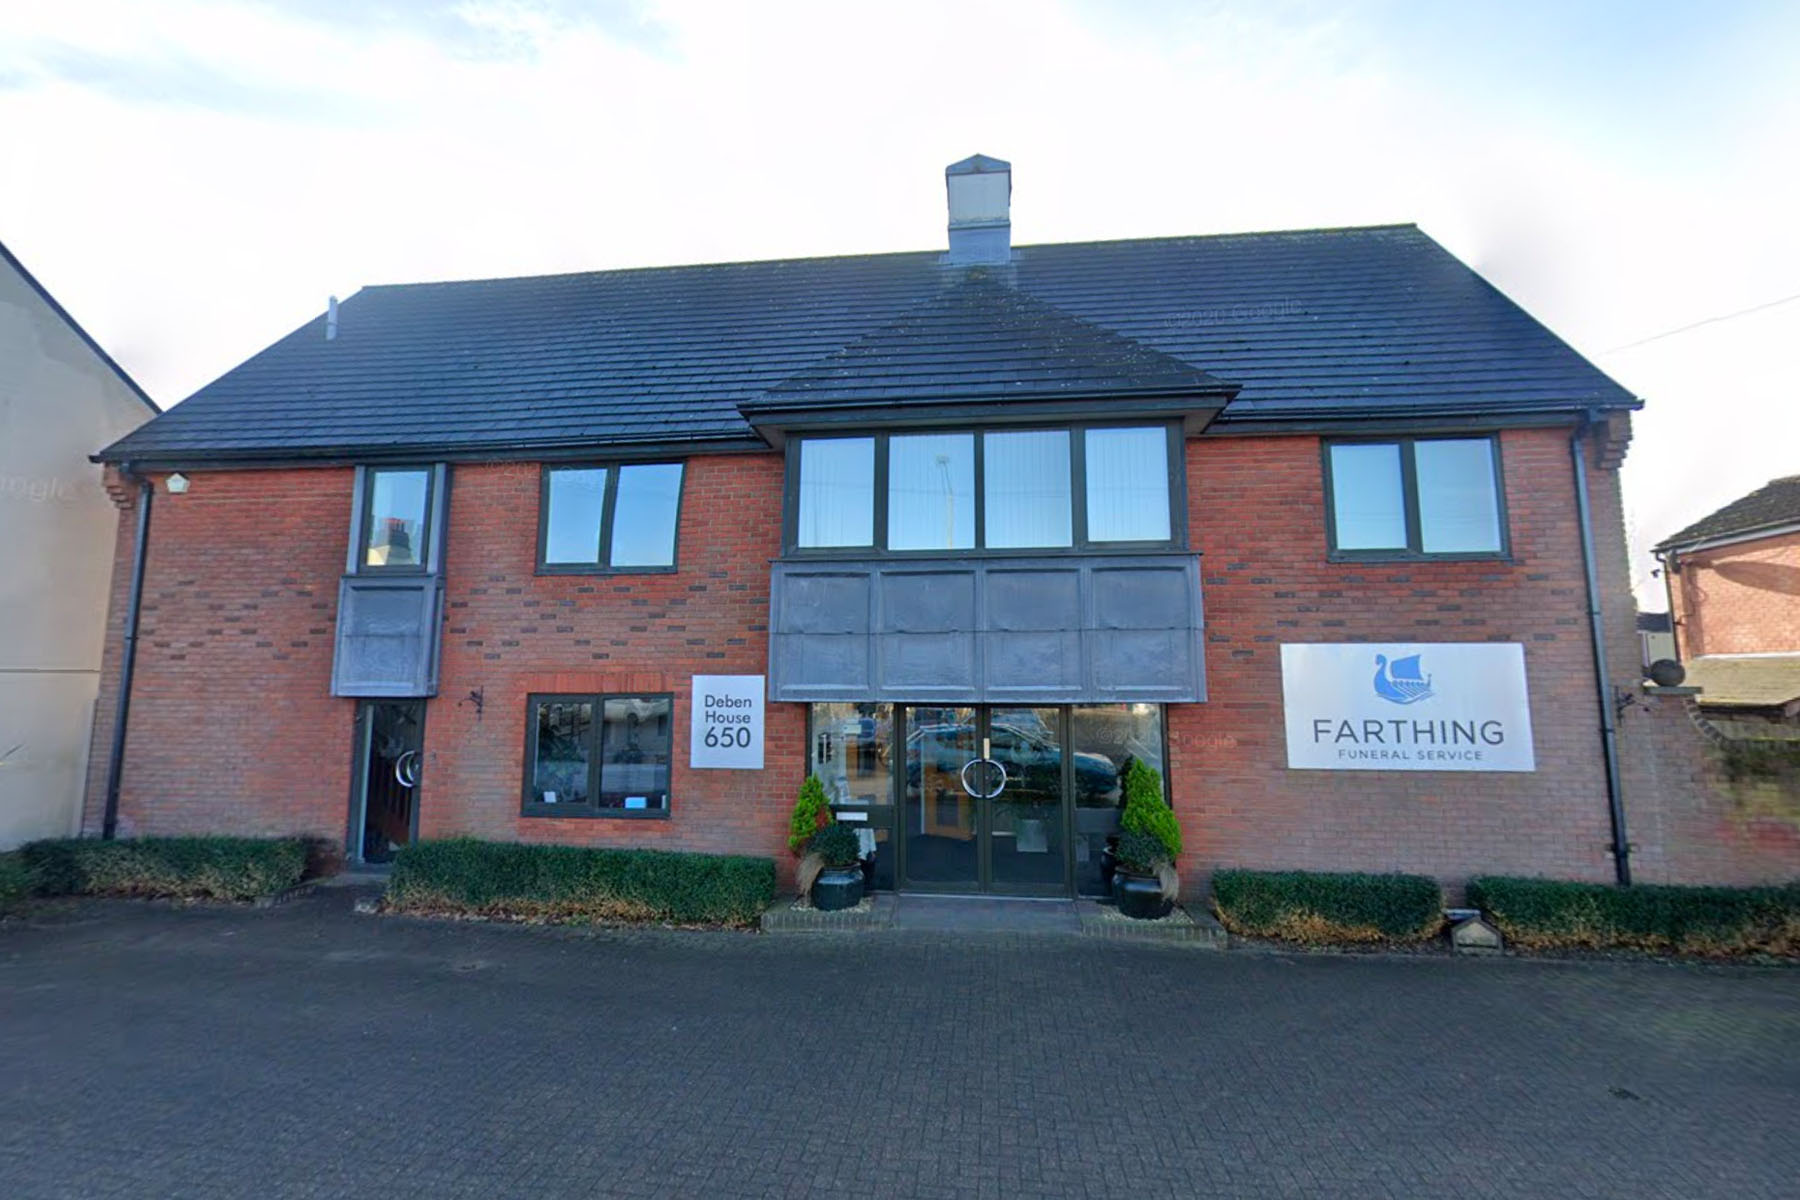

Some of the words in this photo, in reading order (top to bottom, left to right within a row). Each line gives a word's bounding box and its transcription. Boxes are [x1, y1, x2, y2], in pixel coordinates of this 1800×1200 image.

[704, 693, 752, 708] Deben
[704, 710, 751, 724] House
[704, 726, 751, 749] 650
[1313, 719, 1505, 745] FARTHING
[1338, 749, 1410, 761] FUNERAL
[1417, 750, 1483, 762] SERVICE
